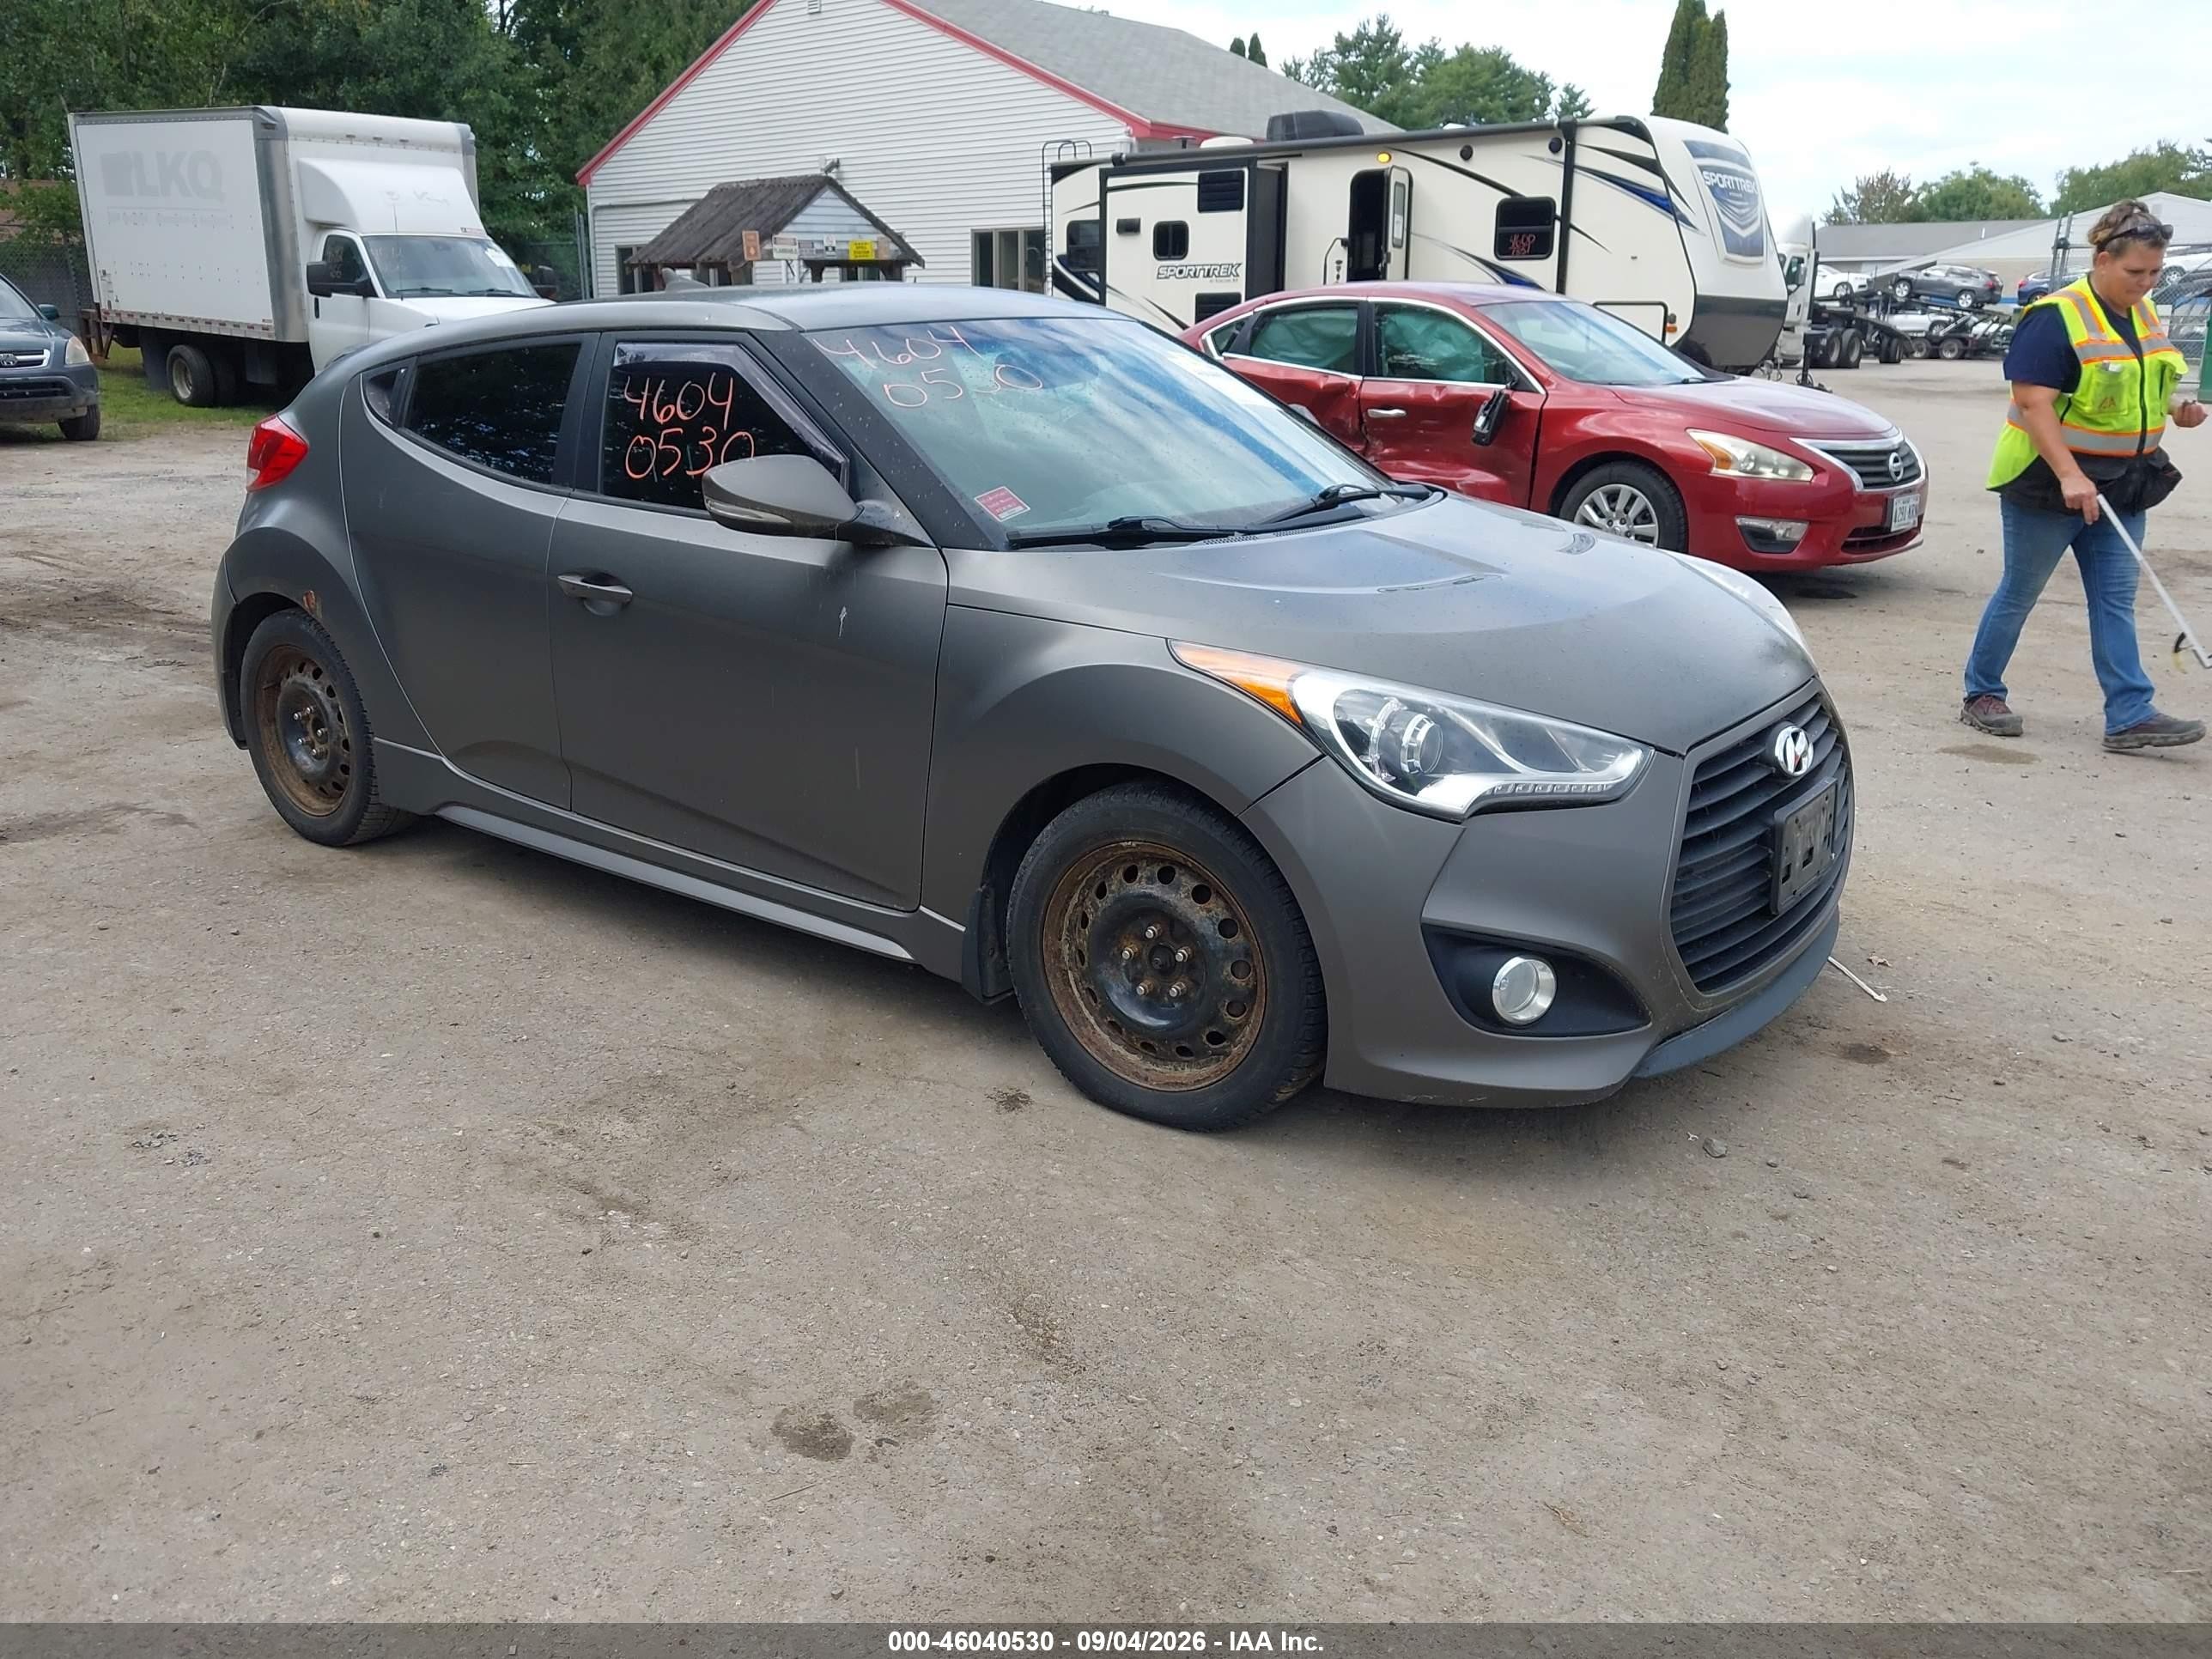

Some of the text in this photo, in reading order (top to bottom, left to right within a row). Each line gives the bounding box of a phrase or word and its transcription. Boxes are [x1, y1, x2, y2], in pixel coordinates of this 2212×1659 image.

[1702, 170, 1759, 195] SPORTTREK
[1157, 263, 1242, 280] SPORTTREK
[812, 325, 986, 369] 4604
[624, 372, 734, 431] 4604
